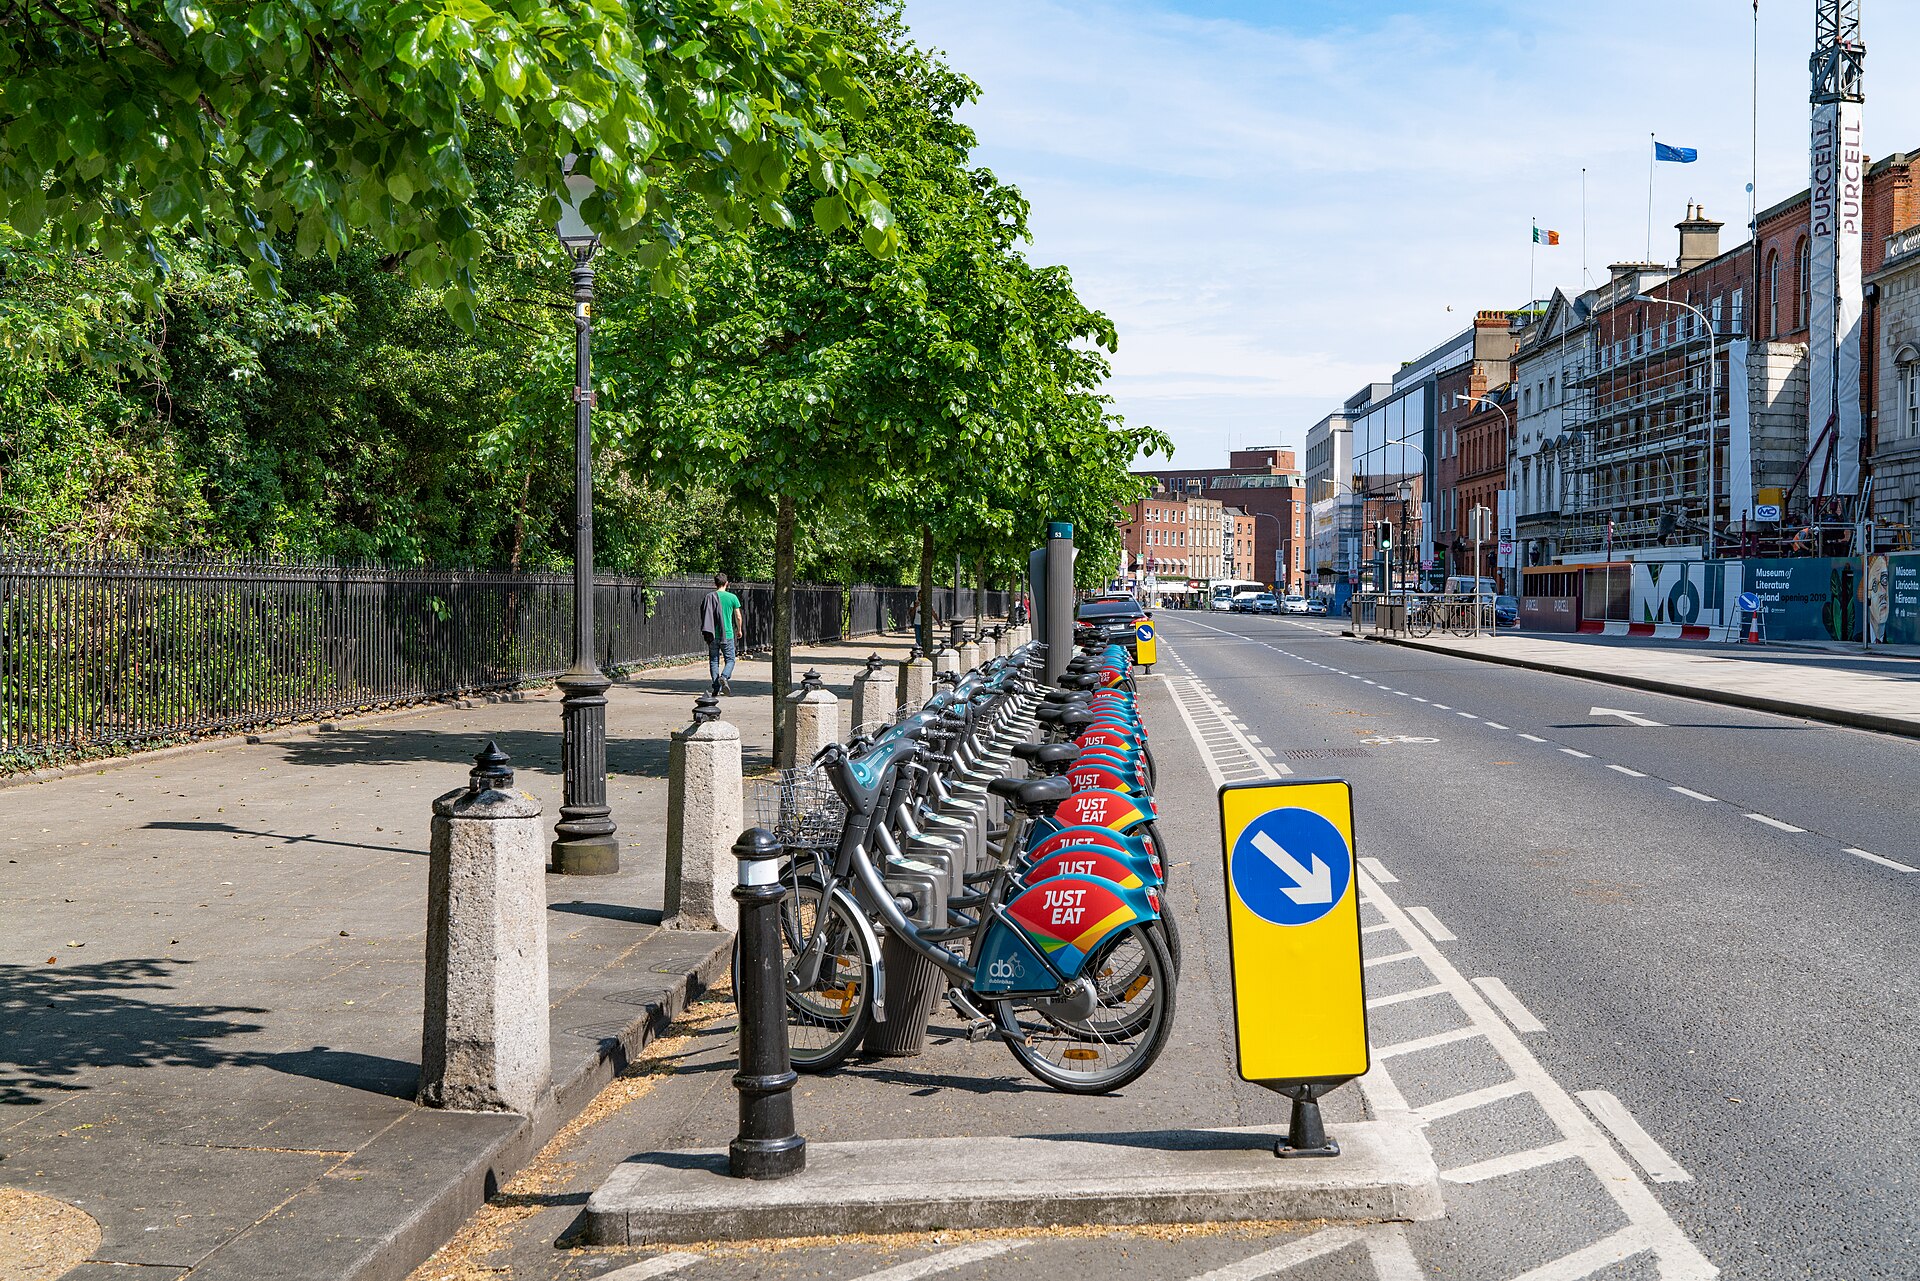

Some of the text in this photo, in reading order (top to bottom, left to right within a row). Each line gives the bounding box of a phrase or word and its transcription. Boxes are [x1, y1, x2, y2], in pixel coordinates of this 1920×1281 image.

[1815, 120, 1832, 237] PURCELL
[1844, 120, 1860, 235] PURCELL
[1756, 568, 1794, 580] Museum of
[1756, 580, 1790, 590] Literature
[1781, 593, 1809, 604] opening
[1810, 593, 1826, 602] 2019
[1084, 736, 1106, 746] JUST
[1074, 774, 1100, 787] JUST
[1076, 798, 1108, 813] JUST
[1082, 810, 1107, 822] EAT
[1058, 860, 1096, 876] JUST
[1042, 890, 1086, 910] JUST
[1052, 908, 1086, 924] EAT
